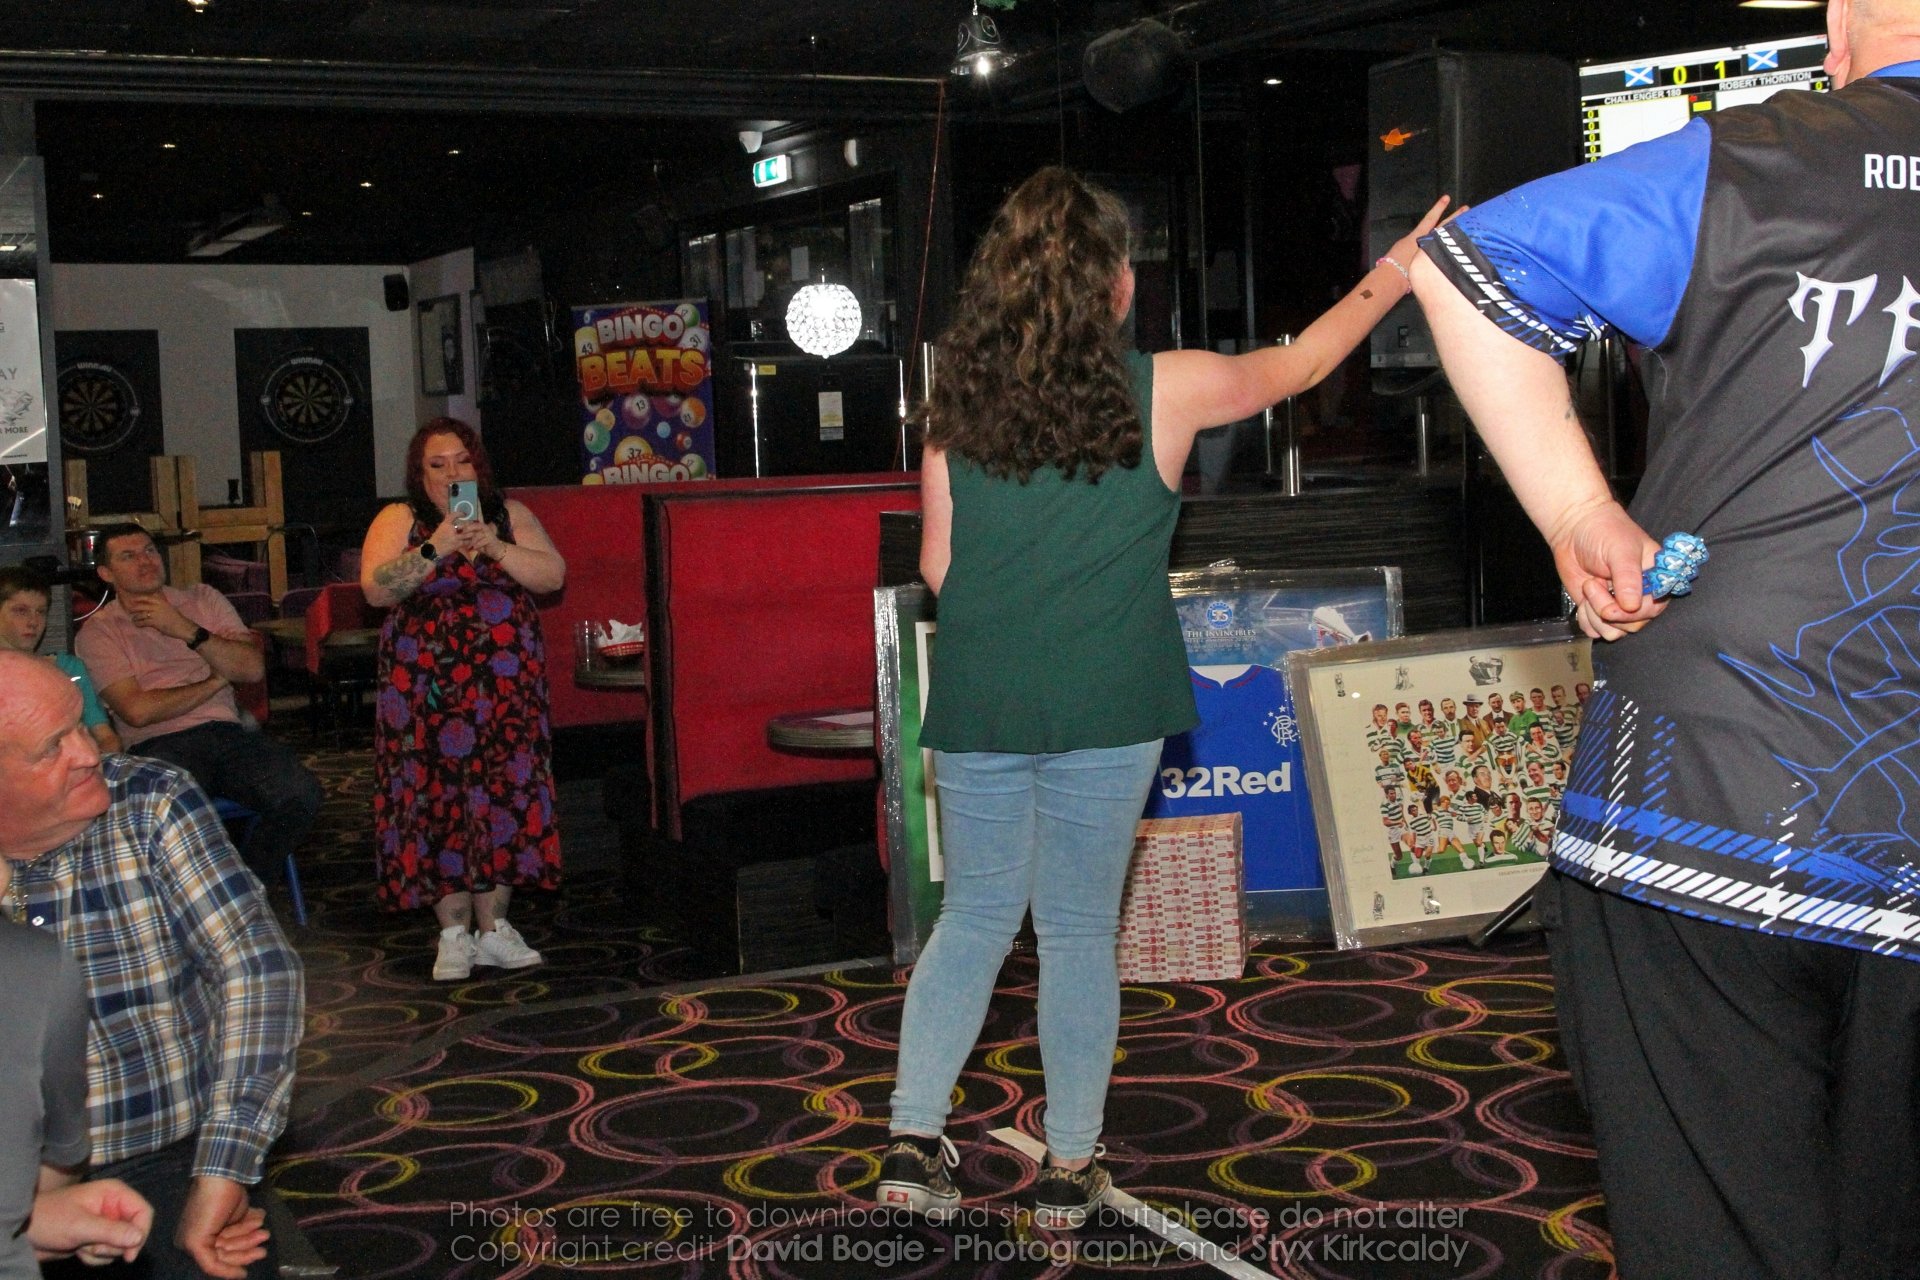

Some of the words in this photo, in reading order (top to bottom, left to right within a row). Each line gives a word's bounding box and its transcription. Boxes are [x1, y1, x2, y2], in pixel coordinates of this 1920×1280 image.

[1673, 66, 1687, 85] 0
[1714, 60, 1726, 79] 1
[1718, 77, 1756, 91] ROBERT
[1757, 71, 1812, 87] THORNTON
[1603, 90, 1665, 105] CHALLENGER
[596, 313, 685, 344] BINGO
[581, 342, 594, 355] 43
[580, 348, 705, 392] BEATS
[635, 400, 646, 411] 13
[4, 426, 29, 435] MORE
[602, 462, 690, 485] BINGO
[1162, 761, 1292, 799] 32Red
